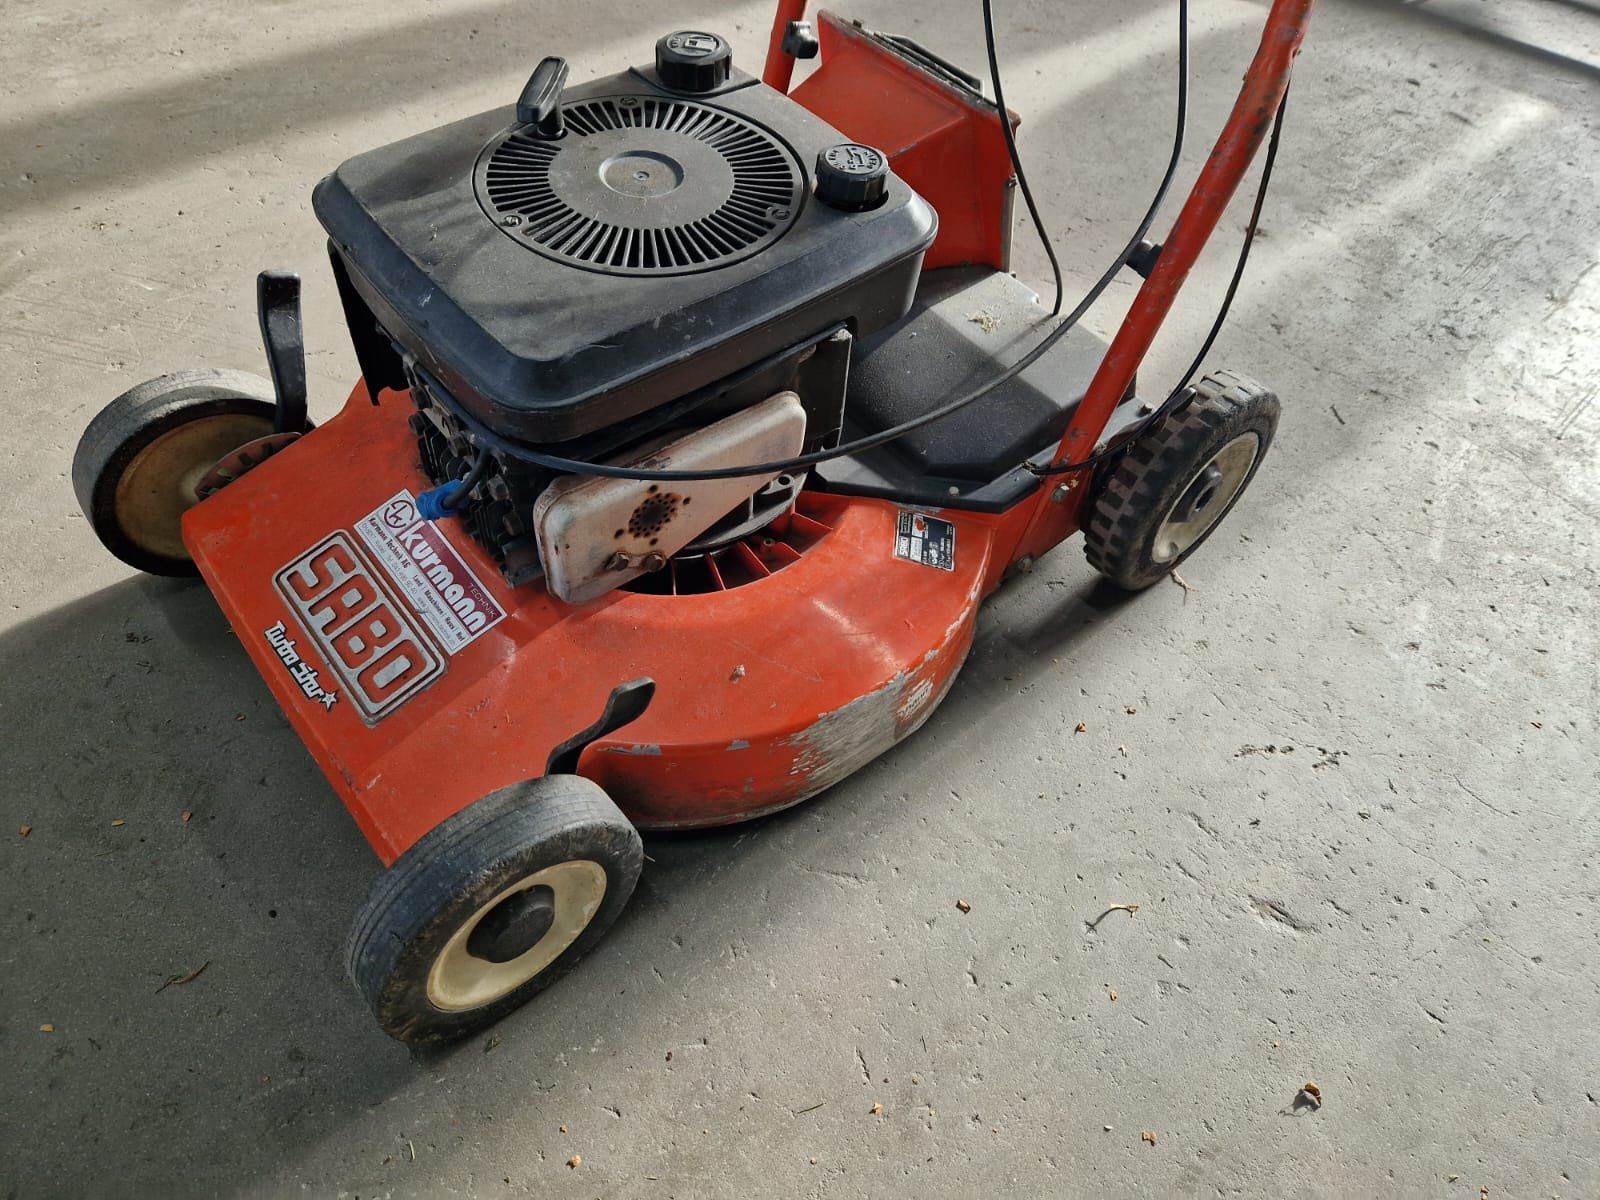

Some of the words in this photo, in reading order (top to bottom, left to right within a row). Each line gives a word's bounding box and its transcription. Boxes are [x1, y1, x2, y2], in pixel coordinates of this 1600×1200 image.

[386, 539, 403, 560] Technik
[398, 522, 487, 633] kurmann
[286, 543, 428, 704] SABO
[468, 583, 497, 618] TECHNIK
